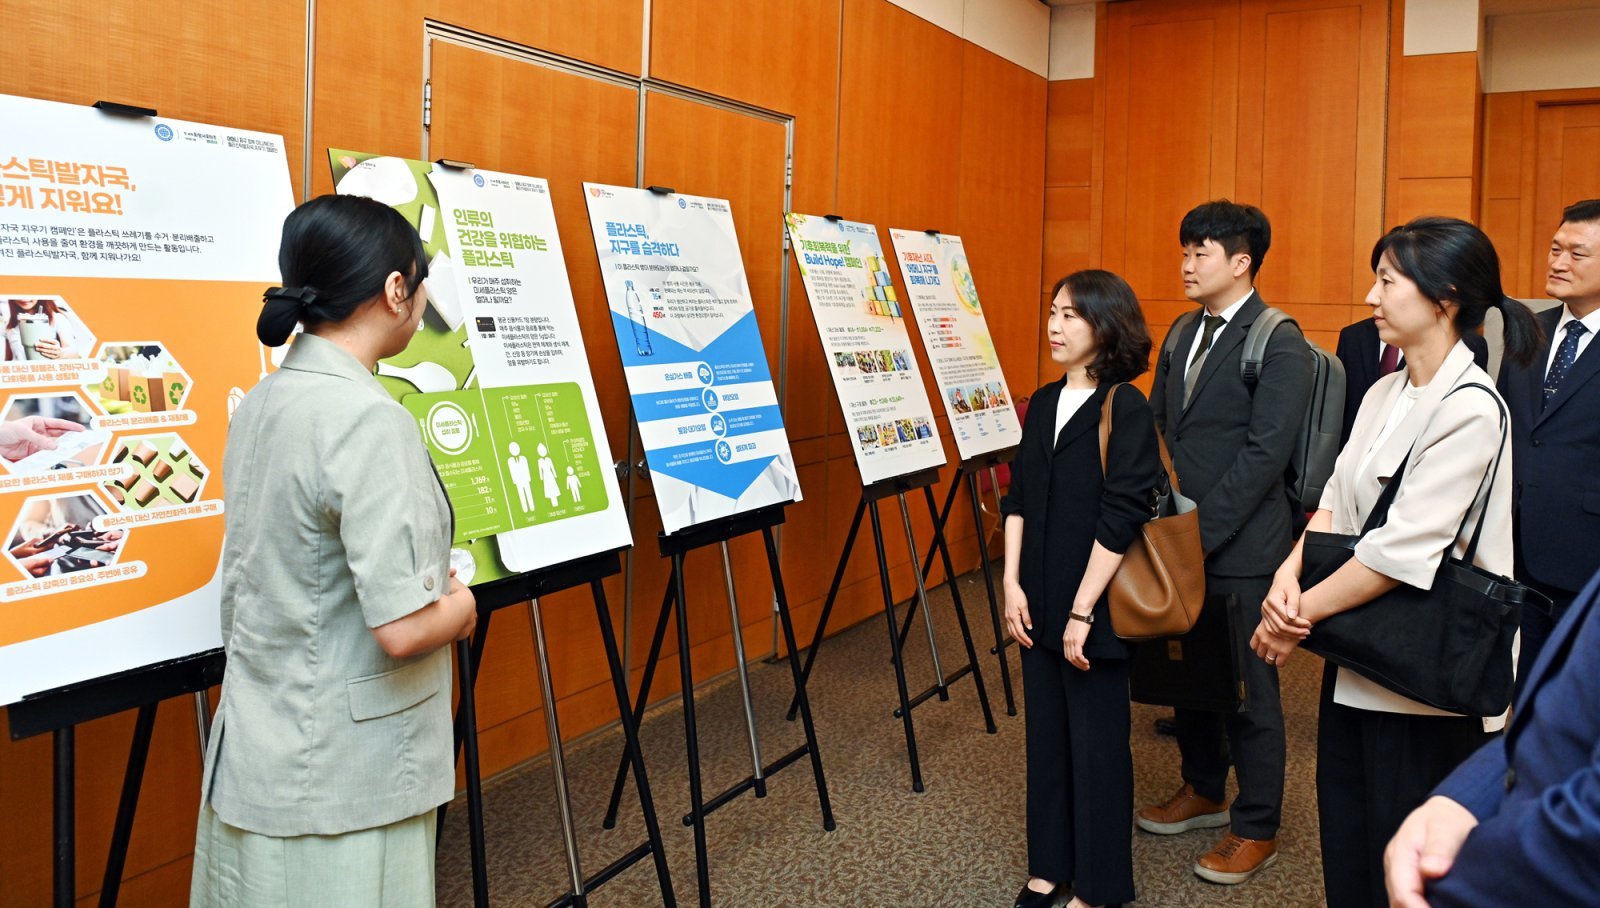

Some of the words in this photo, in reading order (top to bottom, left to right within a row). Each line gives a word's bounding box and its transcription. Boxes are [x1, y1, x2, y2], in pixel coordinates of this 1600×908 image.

[0, 156, 138, 192] 스틱발자국,
[0, 184, 34, 210] 게
[40, 187, 124, 216] 지워요!
[453, 208, 494, 228] 인류의
[21, 224, 48, 234] 지우기
[87, 228, 120, 239] 플라스틱
[122, 230, 153, 241] 쓰레기를
[606, 221, 650, 240] 플라스틱,
[32, 237, 58, 248] 사용을
[61, 238, 78, 248] 줄여
[80, 240, 104, 250] 환경을
[106, 240, 137, 251] 깨끗하게
[139, 241, 162, 252] 만드는
[164, 243, 202, 254] 활동입니다.
[457, 229, 498, 248] 건강을
[500, 232, 547, 252] 위협하는
[609, 239, 641, 256] 지구를
[642, 241, 680, 258] 습격하다
[17, 249, 80, 260] 플라스틱발자국,
[81, 252, 98, 261] 함께
[462, 249, 514, 268] 플라스틱
[804, 253, 824, 266] Build
[823, 254, 845, 269] Hope!
[471, 276, 488, 285] 우리가
[473, 287, 506, 295] 미세플라스틱
[12, 365, 29, 373] 대신
[664, 372, 684, 382] 온실가스
[100, 419, 129, 428] 플라스틱
[0, 478, 21, 488] 요한
[23, 474, 56, 486] 플라스틱
[58, 472, 74, 481] 제품
[75, 469, 107, 479] 구매하지
[103, 516, 135, 528] 플라스틱
[135, 513, 150, 522] 대신
[203, 503, 217, 512] 구매
[6, 583, 41, 597] 플라스틱
[69, 573, 96, 585] 중요성,
[97, 568, 121, 579] 주변에
